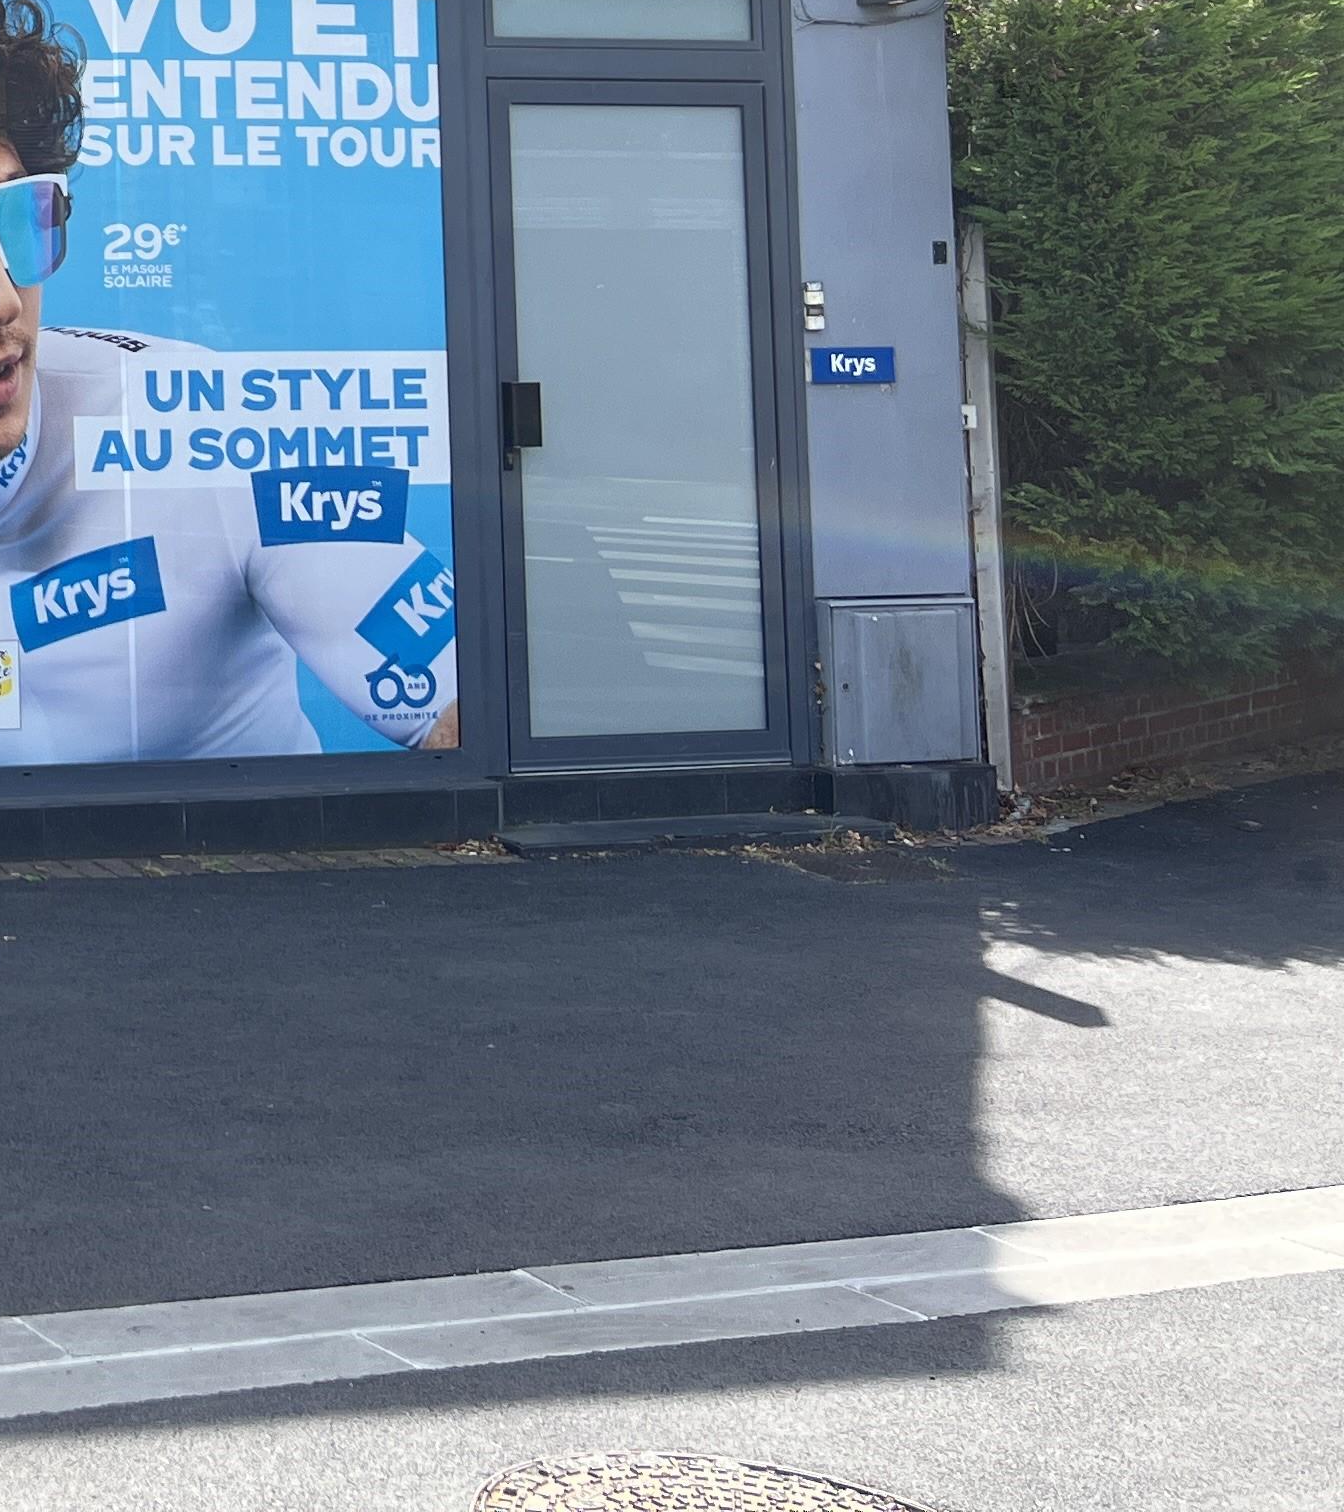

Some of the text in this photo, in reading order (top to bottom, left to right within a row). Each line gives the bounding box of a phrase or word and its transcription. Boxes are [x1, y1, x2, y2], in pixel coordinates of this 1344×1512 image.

[85, 59, 441, 123] ENTENDU
[76, 124, 442, 168] SUR LE TOUR
[103, 263, 173, 275] LE MASQUE
[103, 275, 173, 289] SOLAIRE
[829, 352, 877, 377] Krys
[144, 368, 428, 413] UN STYLE
[91, 426, 430, 473] AU SOMMET
[279, 481, 383, 531] Krys
[32, 566, 137, 625] Krys
[382, 710, 439, 721] PROXIMITÉ
